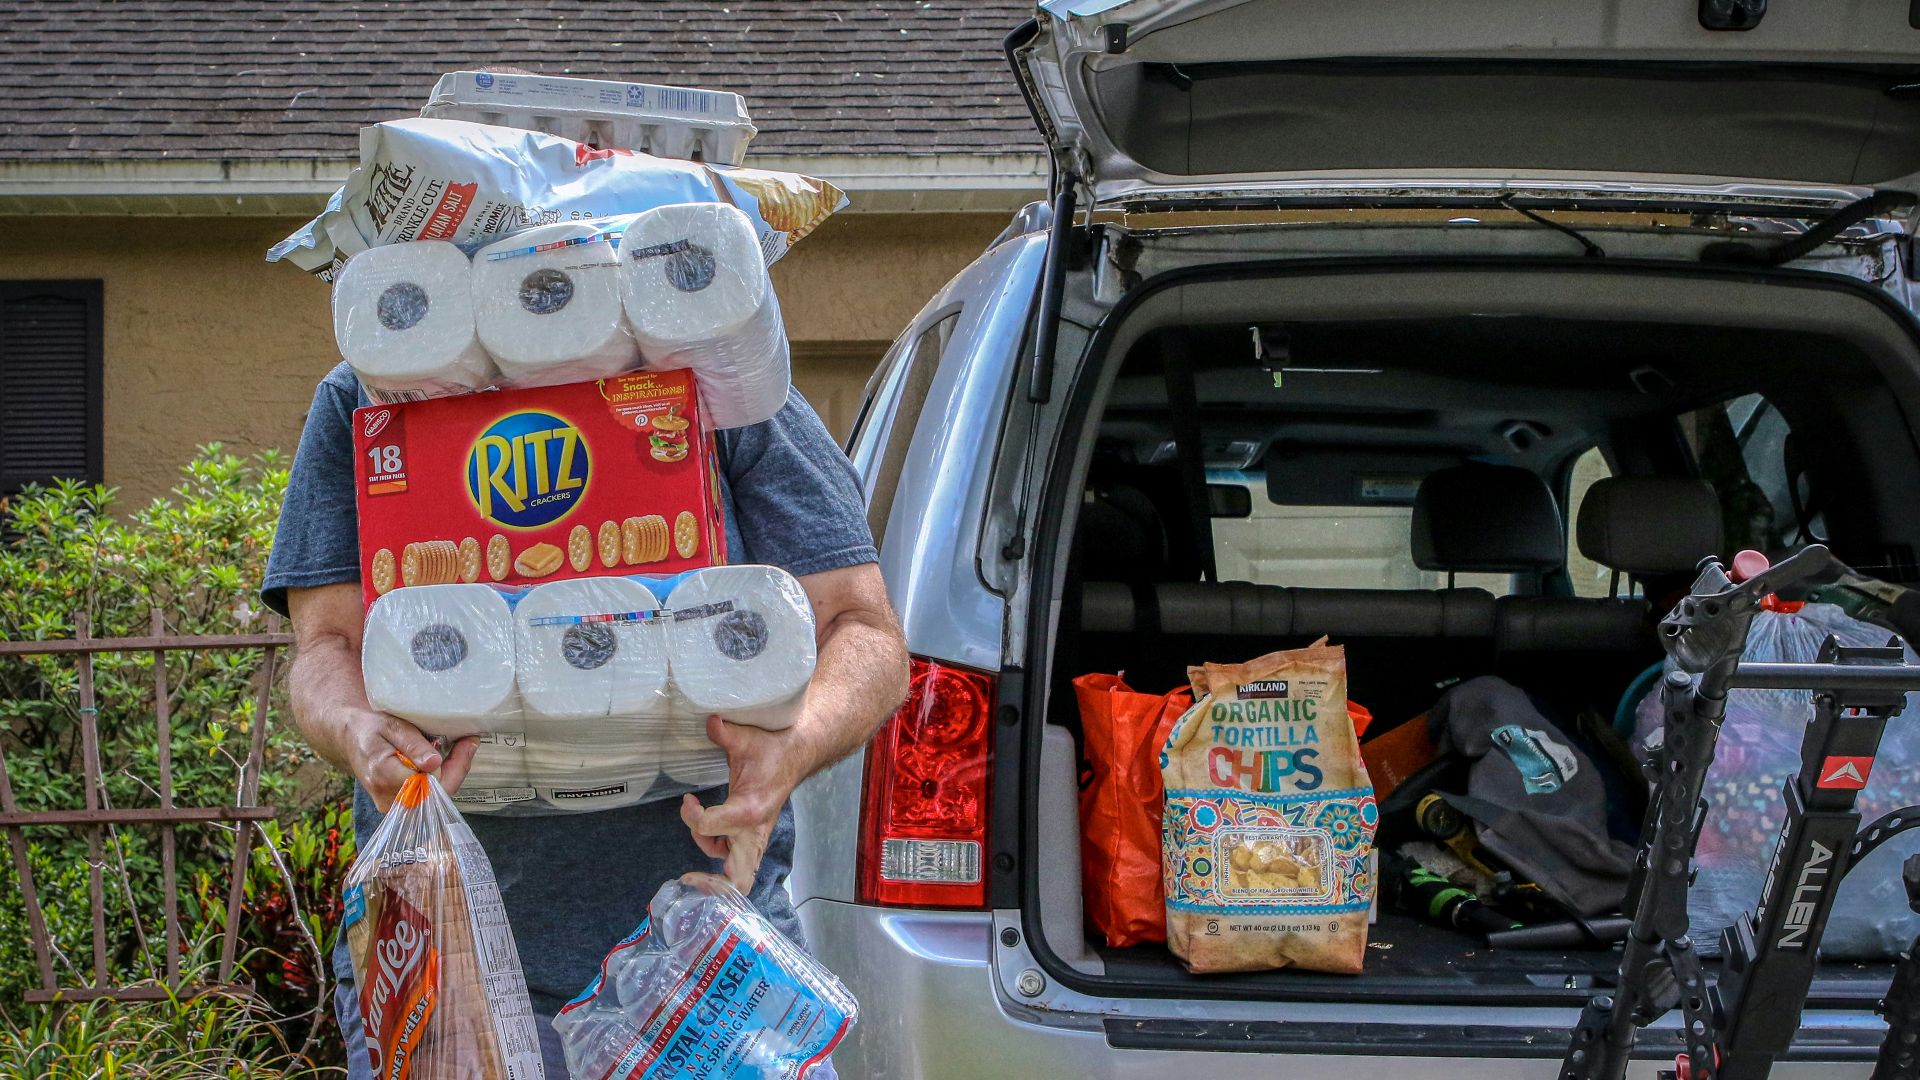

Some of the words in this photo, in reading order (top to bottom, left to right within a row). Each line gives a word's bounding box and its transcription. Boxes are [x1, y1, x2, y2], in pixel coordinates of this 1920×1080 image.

[394, 198, 415, 226] BRAND
[443, 190, 463, 212] SALT
[484, 202, 507, 235] PROMISE
[612, 385, 686, 402] INSPIRATIONS!
[623, 380, 654, 392] Snack
[366, 412, 388, 436] NABISCO
[368, 445, 402, 474] 18
[476, 427, 582, 519] RITZ
[530, 492, 571, 507] CRACKERS
[1239, 682, 1287, 692] KIRKLAND
[1211, 698, 1318, 723] ORGANIC
[1211, 724, 1320, 748] TORTILLA
[1208, 746, 1324, 793] CHIPS
[557, 787, 622, 799] KIRKLAND
[1778, 840, 1833, 948] ALLEN
[377, 920, 425, 998] Lee
[400, 995, 429, 1044] WHEAT
[642, 1029, 672, 1065] BOTTLED
[672, 1013, 682, 1026] AT
[684, 995, 698, 1011] THE
[698, 958, 722, 995] SOURCE
[647, 1026, 706, 1080] RYSTAL
[696, 954, 754, 1026] GEYSER
[707, 1020, 743, 1066] SPRING
[738, 979, 770, 1021] WATER
[686, 1001, 742, 1074] NATURAL
[617, 1049, 640, 1075] CRYSTAL
[721, 1064, 729, 1074] BY
[726, 1056, 735, 1064] CG
